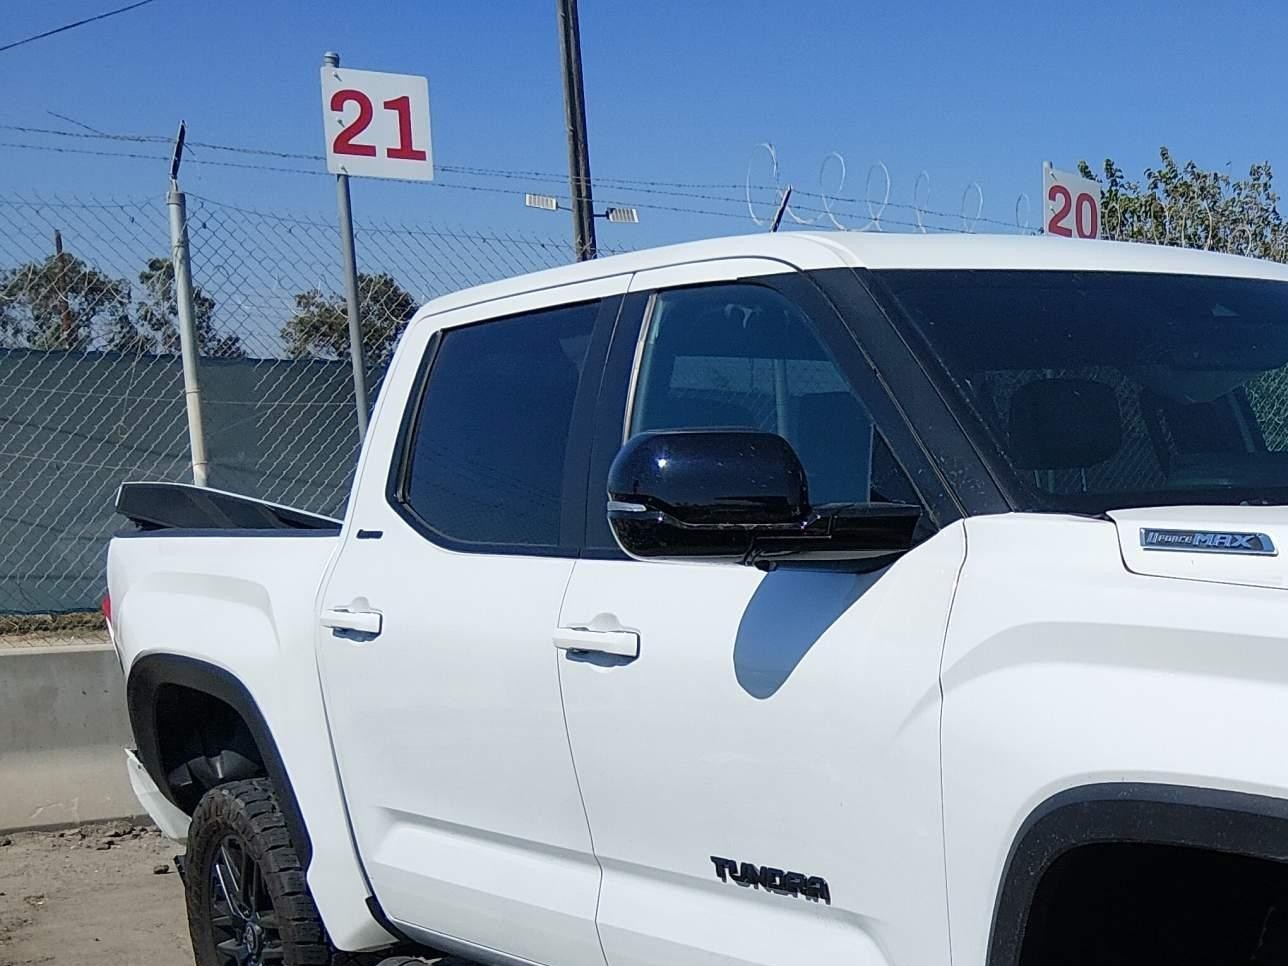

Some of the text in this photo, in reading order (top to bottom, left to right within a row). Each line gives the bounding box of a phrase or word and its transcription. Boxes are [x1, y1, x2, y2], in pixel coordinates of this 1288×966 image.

[330, 89, 427, 161] 21
[1048, 184, 1098, 239] 20
[1193, 532, 1256, 549] MAX
[710, 855, 832, 905] TUNDRA
